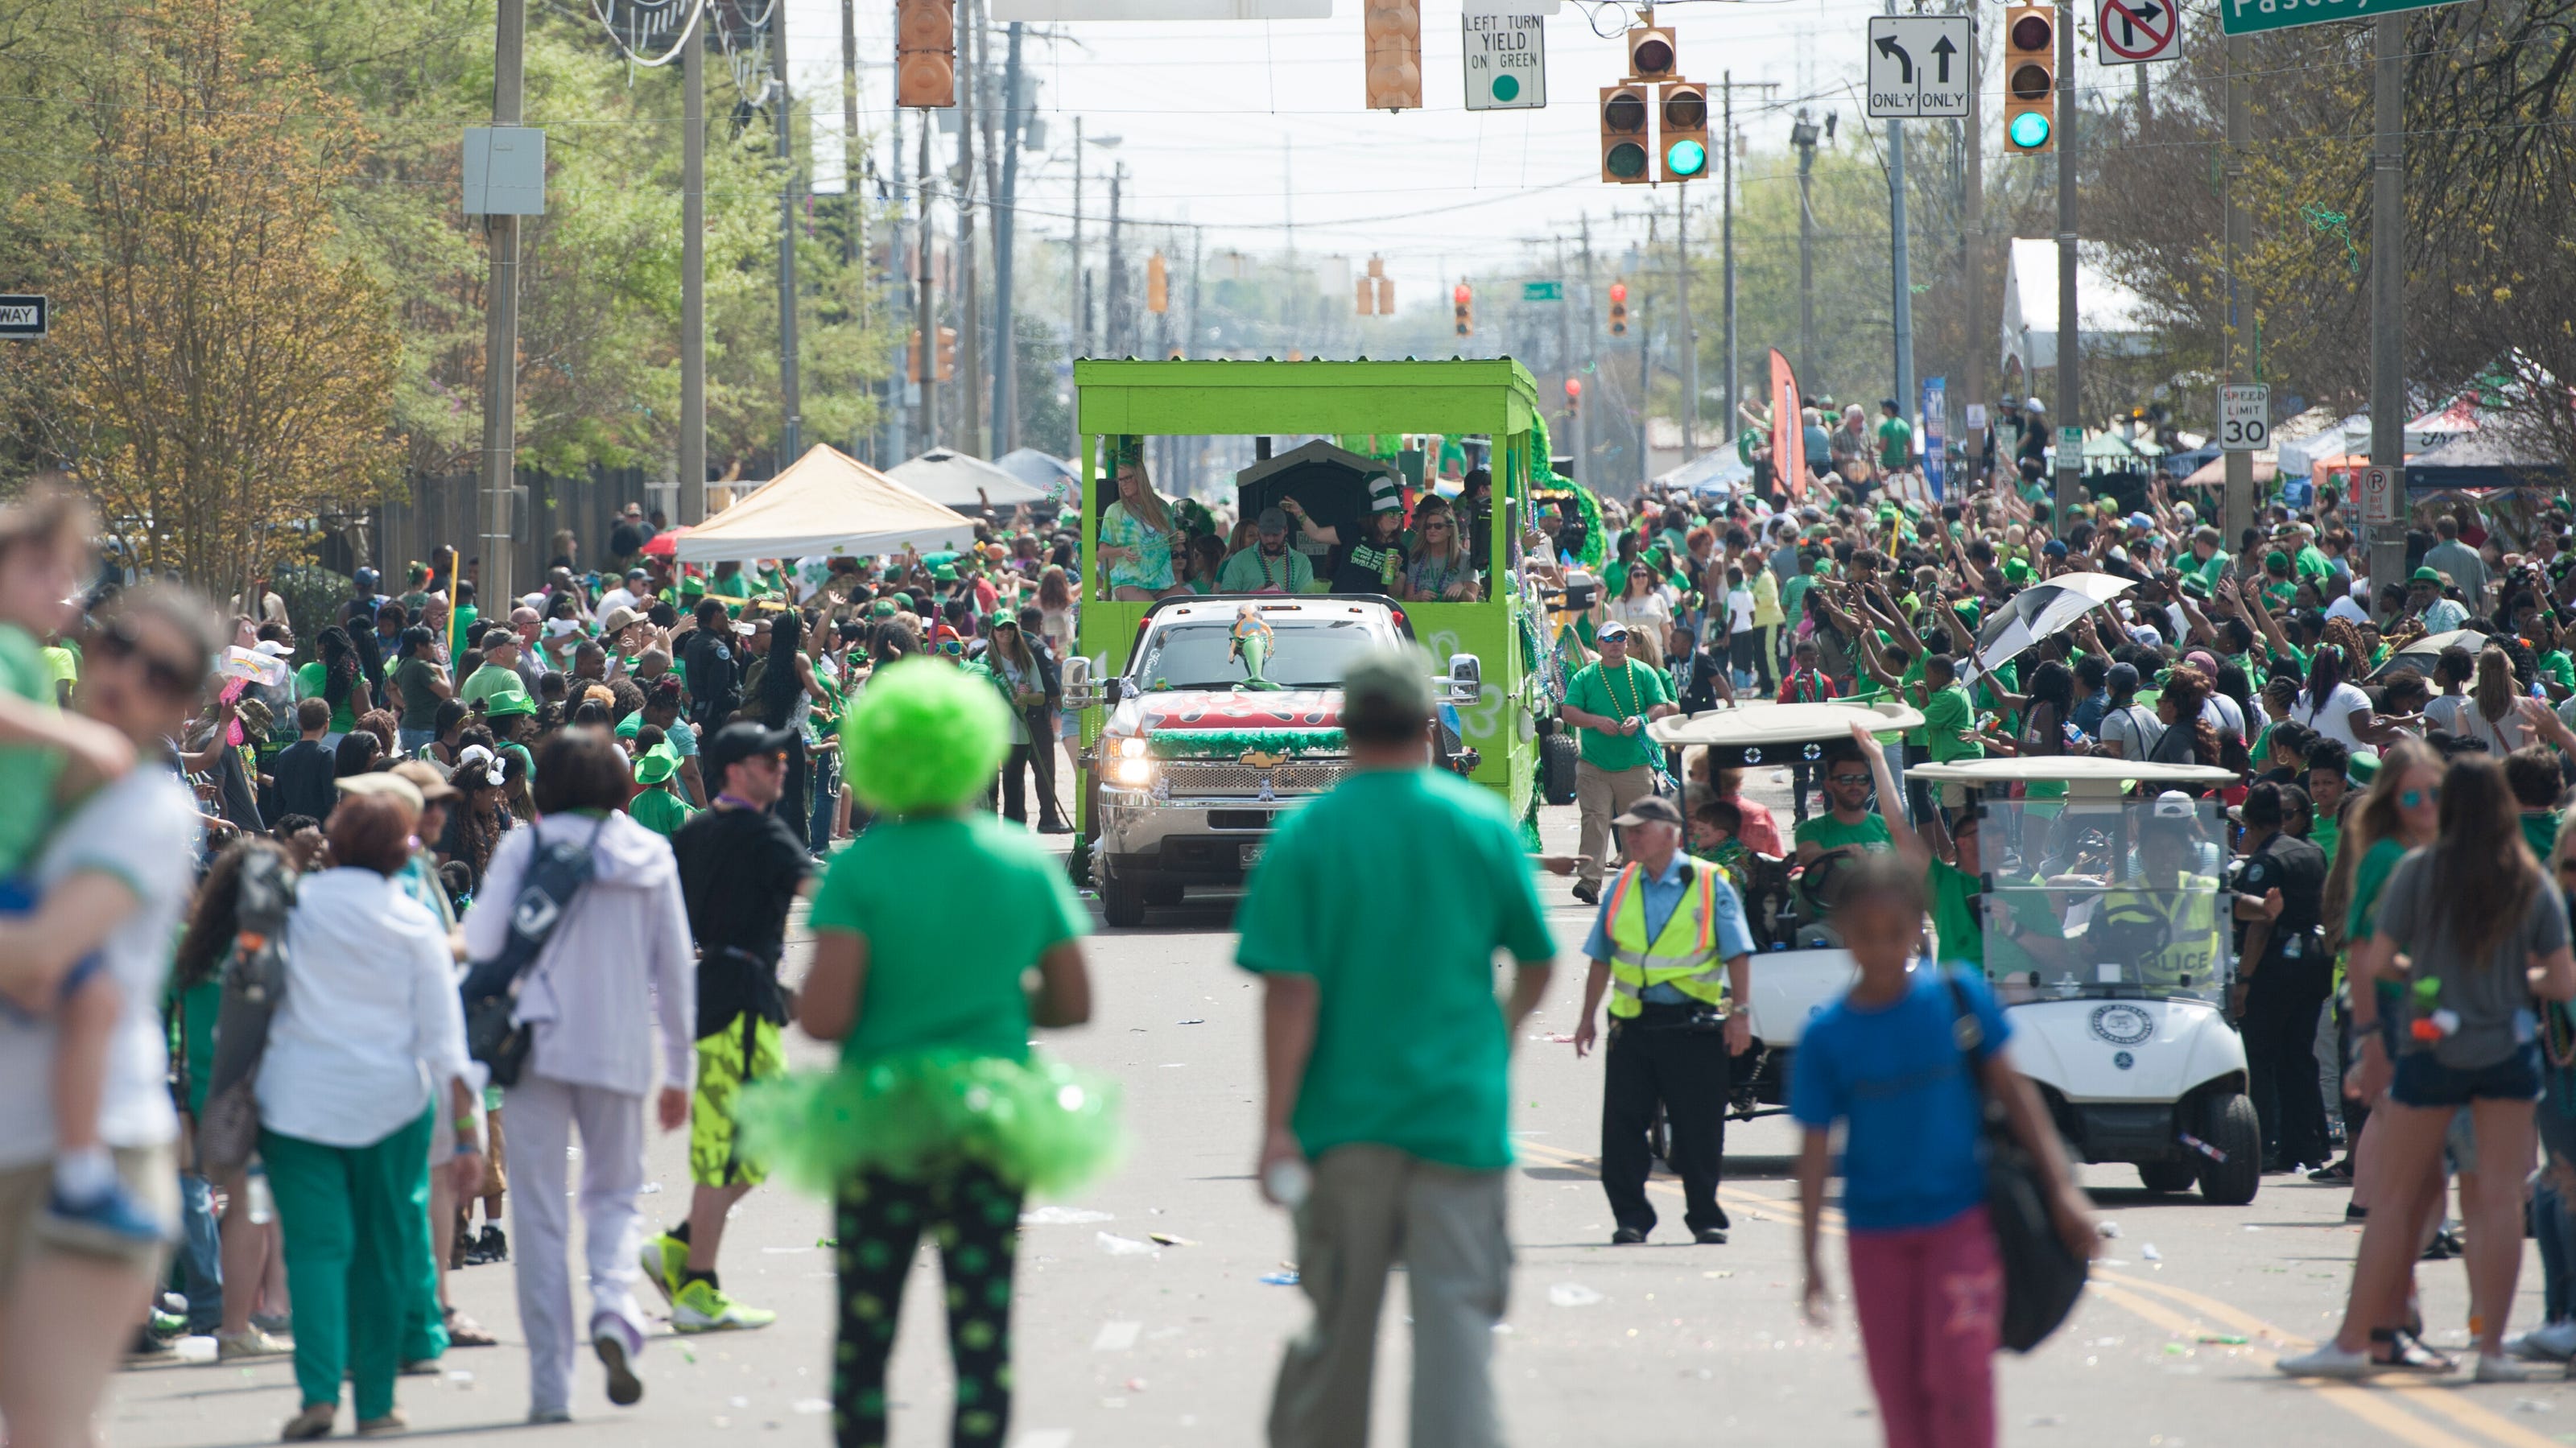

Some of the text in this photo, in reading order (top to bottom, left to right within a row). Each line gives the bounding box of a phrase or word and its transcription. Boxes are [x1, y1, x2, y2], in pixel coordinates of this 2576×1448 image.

[1465, 14, 1540, 31] LEFT TURN
[1481, 32, 1526, 51] YIELD
[1472, 52, 1538, 69] ON GREEN
[1872, 93, 1915, 108] ONLY
[1922, 93, 1965, 107] ONLY
[0, 308, 32, 323] WAY
[2223, 391, 2265, 402] SPEED
[2227, 406, 2260, 416] LIMIT
[2225, 420, 2265, 443] 30
